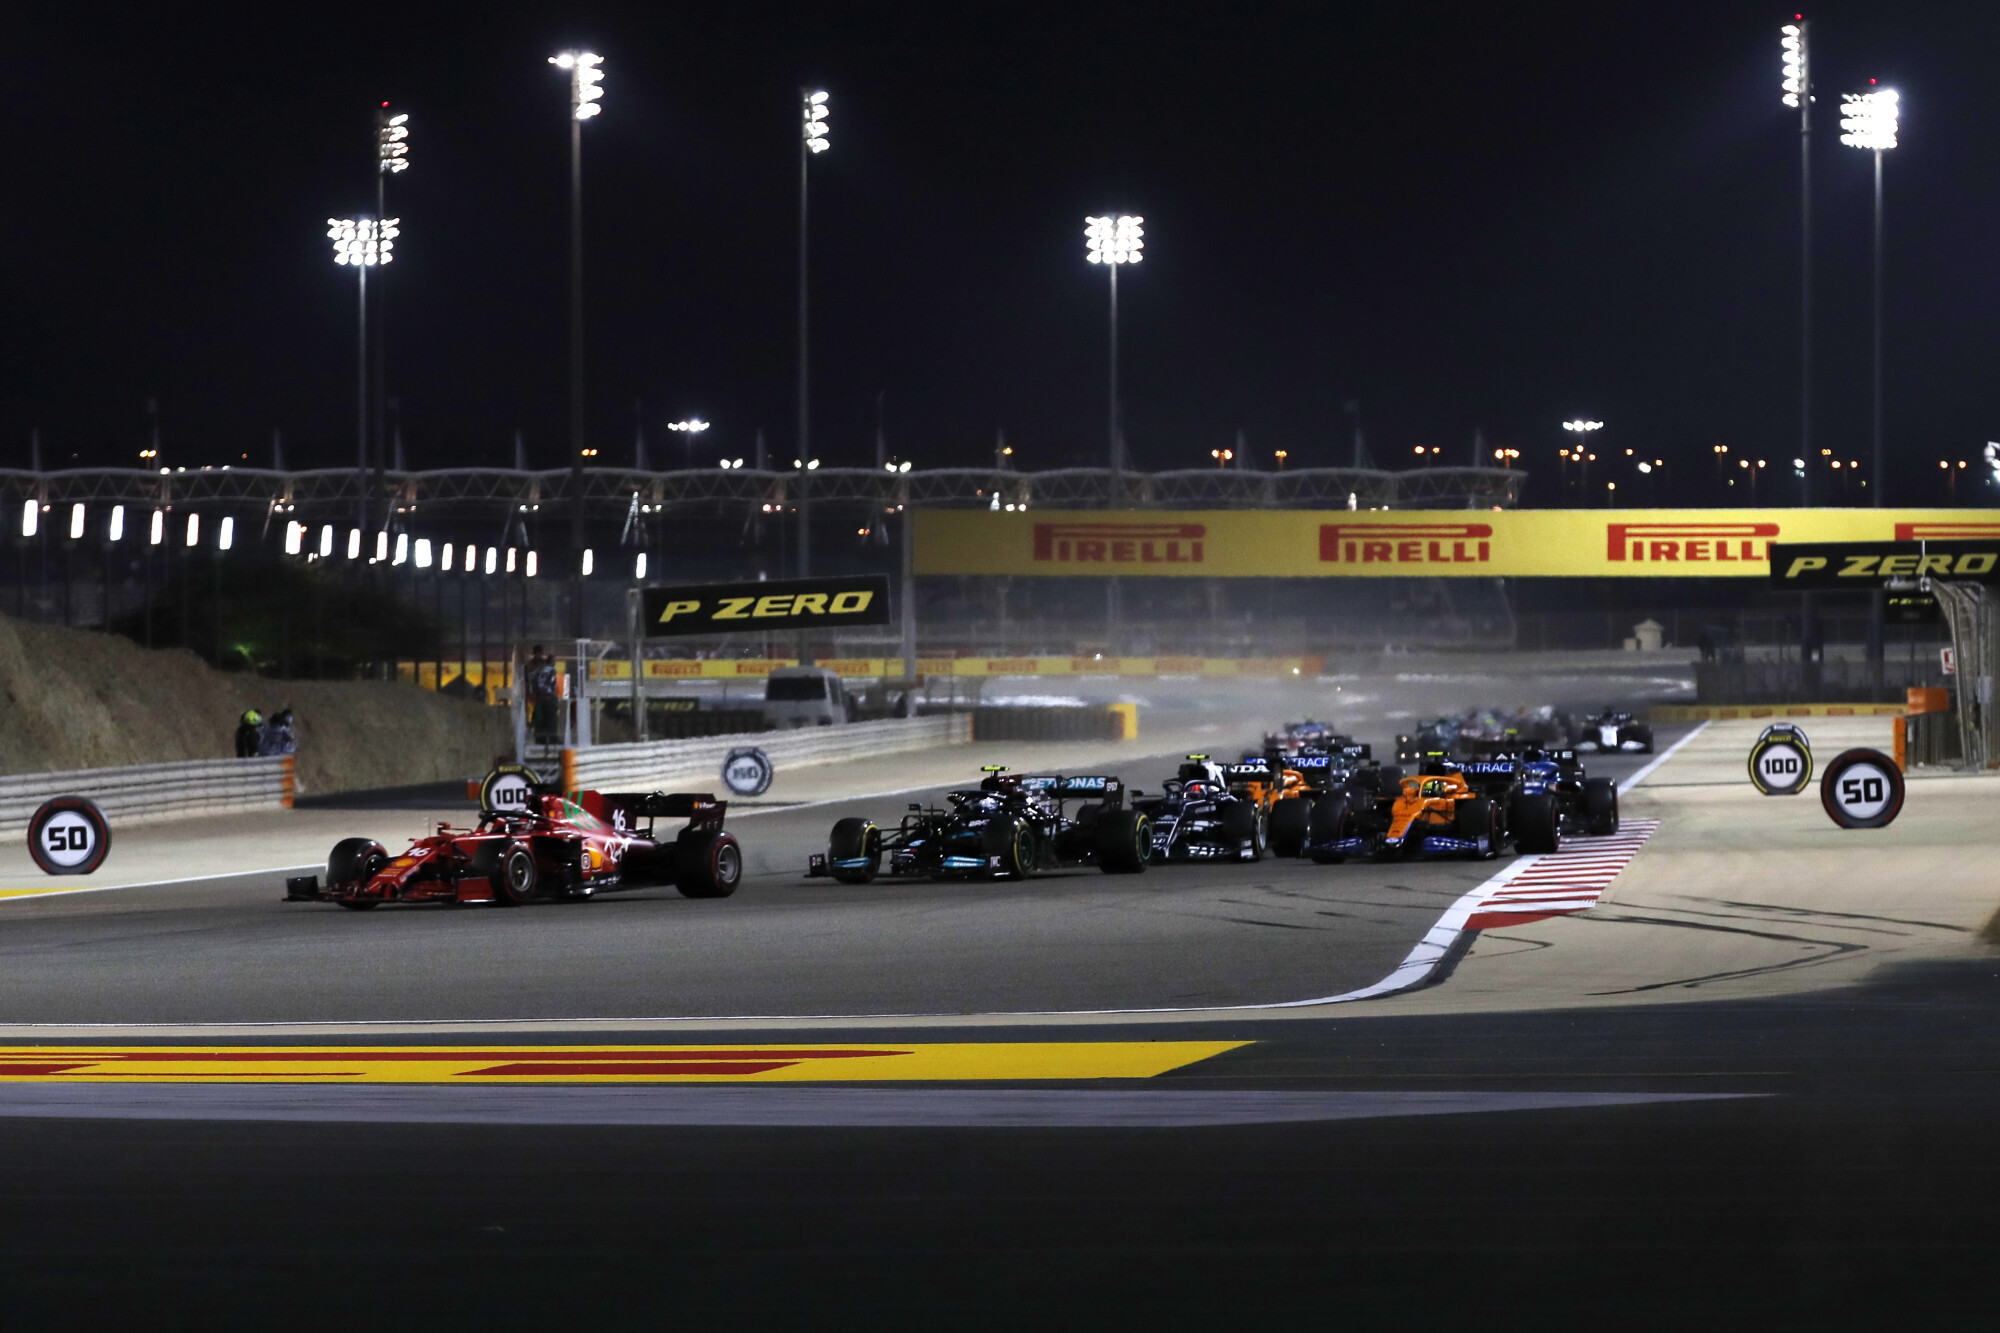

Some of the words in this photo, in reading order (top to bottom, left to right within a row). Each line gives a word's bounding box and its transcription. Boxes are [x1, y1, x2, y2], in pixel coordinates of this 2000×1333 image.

[1034, 524, 1206, 562] PIRELLI
[1319, 524, 1493, 562] PIRELLI
[1785, 557, 1828, 578] P
[1837, 553, 1998, 577] ZERO
[659, 600, 701, 623] P
[711, 591, 874, 620] ZERO
[1765, 758, 1798, 775] 100
[1842, 777, 1884, 804] 50
[612, 809, 627, 831] 16
[48, 825, 88, 851] 50
[408, 847, 431, 857] 16
